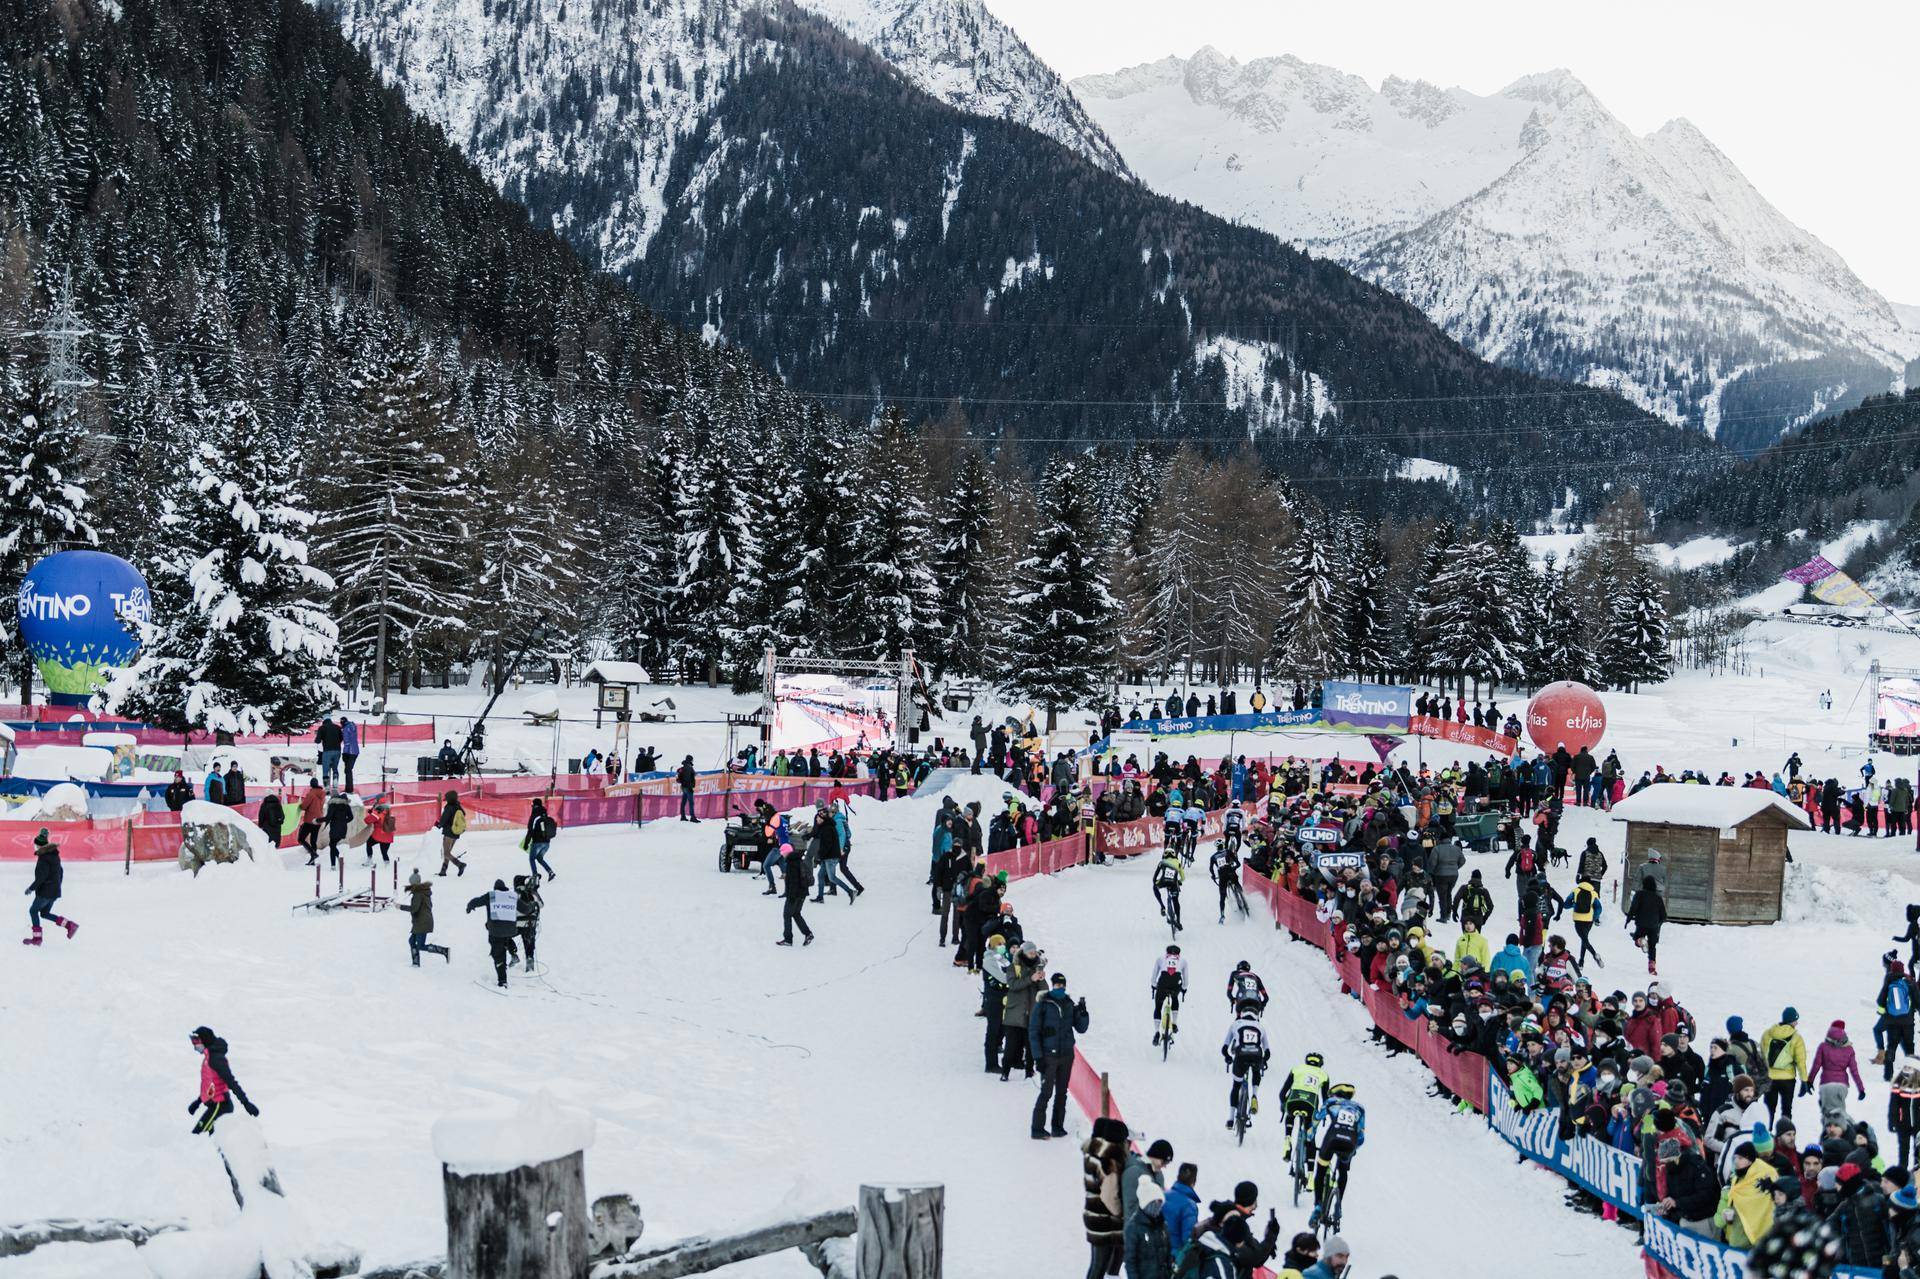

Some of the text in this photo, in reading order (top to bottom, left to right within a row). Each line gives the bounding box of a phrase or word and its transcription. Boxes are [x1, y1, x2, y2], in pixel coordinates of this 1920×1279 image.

[19, 592, 91, 621] ENTINO
[1335, 694, 1398, 715] TRENTINO
[1276, 712, 1313, 724] TRENTINO
[1566, 705, 1603, 732] ethias
[1157, 721, 1194, 732] TRENTINO
[1301, 830, 1334, 841] OLMO
[1320, 856, 1358, 867] OLMO
[1246, 980, 1256, 989] 22
[1246, 1033, 1255, 1041] 17
[1306, 1076, 1317, 1086] 31
[1339, 1112, 1353, 1123] 35
[1561, 1126, 1643, 1208] SHIMAN
